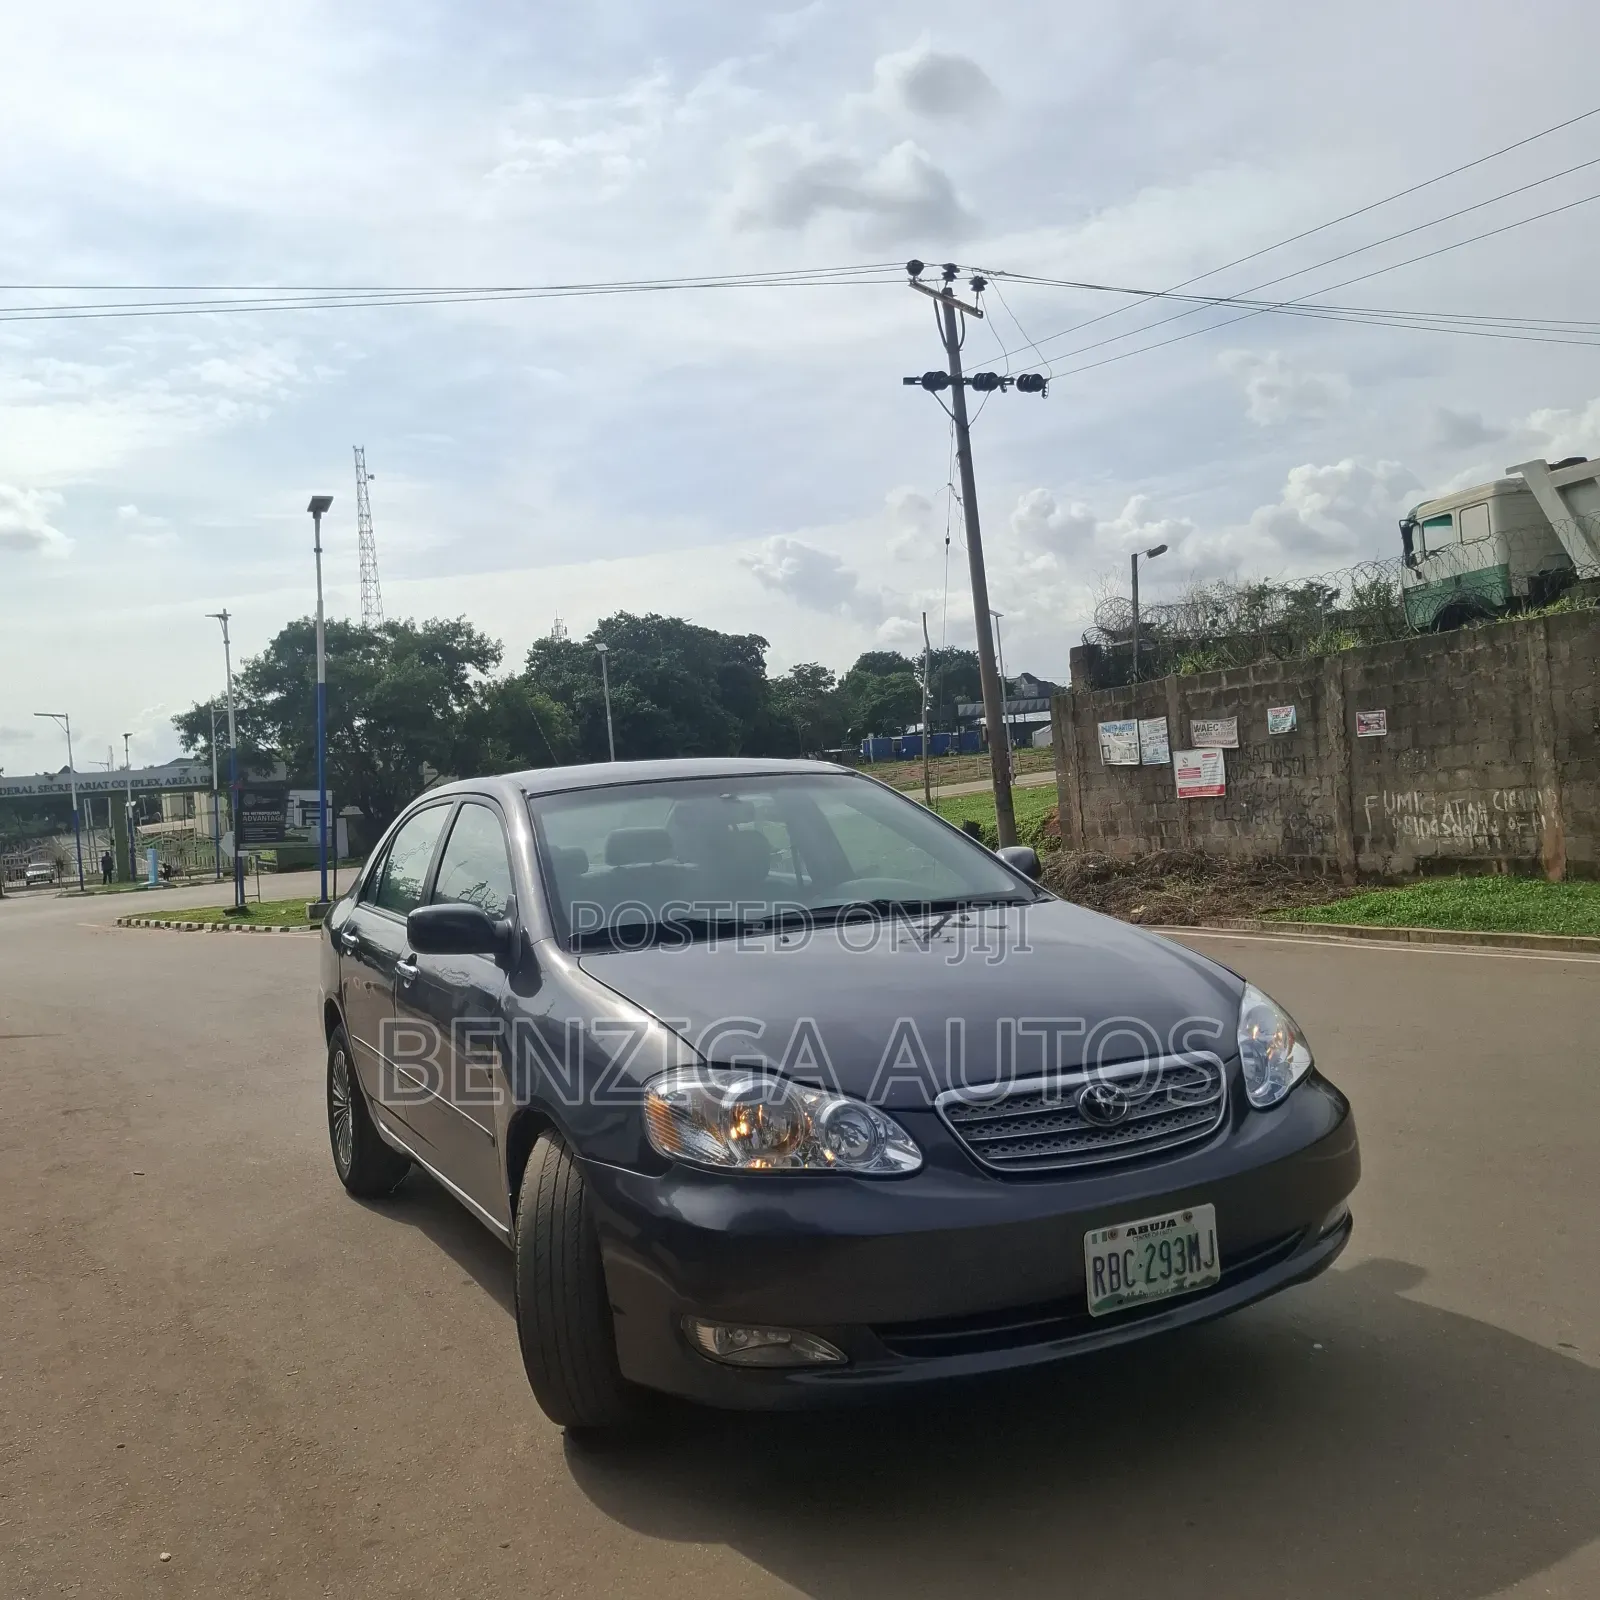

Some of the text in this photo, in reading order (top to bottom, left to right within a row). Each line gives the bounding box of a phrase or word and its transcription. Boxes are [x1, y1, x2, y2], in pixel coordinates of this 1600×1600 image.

[1193, 723, 1219, 733] WAEC
[38, 781, 110, 793] SECREARIAT
[1126, 1218, 1177, 1237] ABUJA
